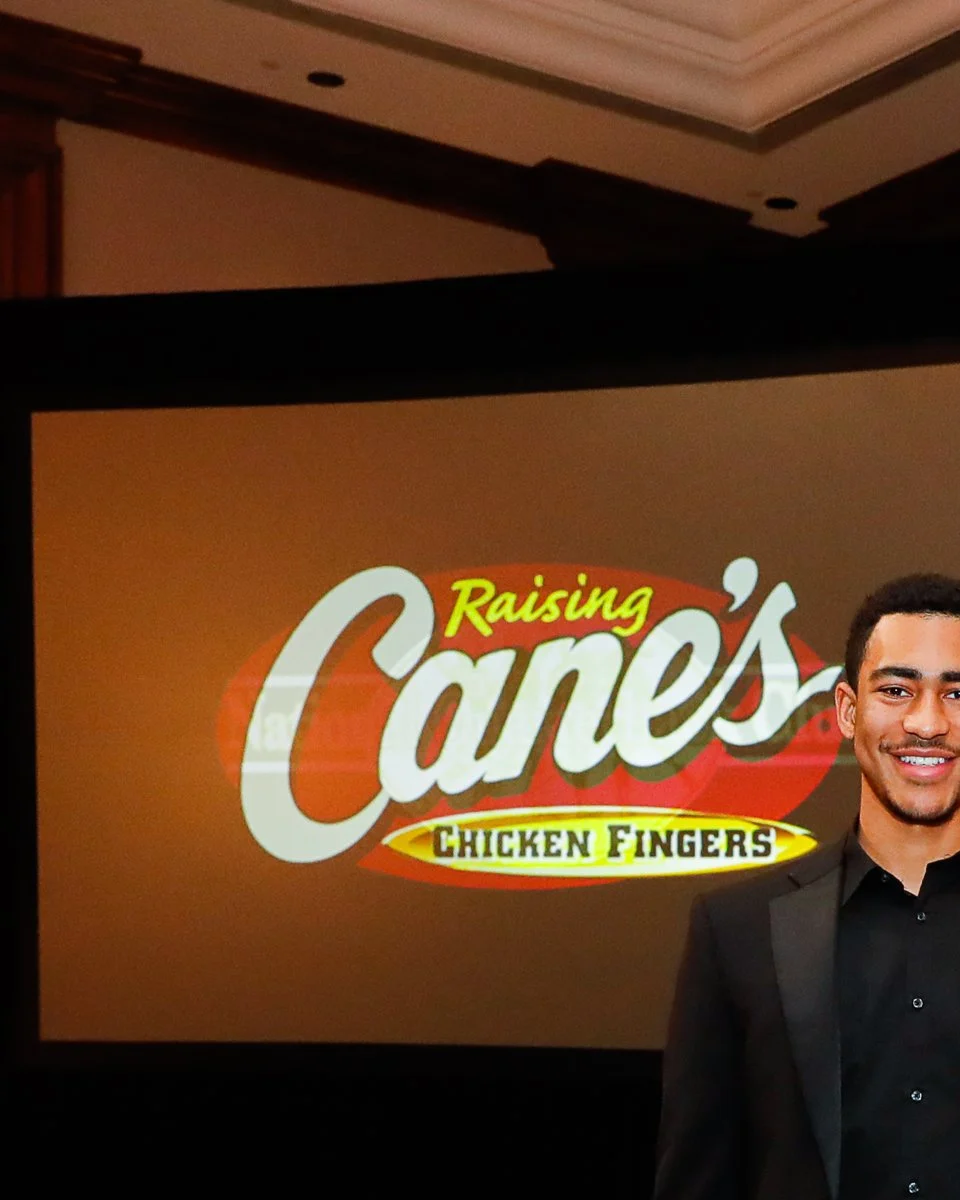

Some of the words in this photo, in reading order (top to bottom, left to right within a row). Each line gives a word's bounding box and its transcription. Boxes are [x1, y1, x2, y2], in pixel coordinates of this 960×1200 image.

[443, 573, 654, 638] Raising
[240, 557, 845, 863] Cane's
[432, 824, 591, 859] CHICKEN
[606, 824, 774, 859] FINGERS
